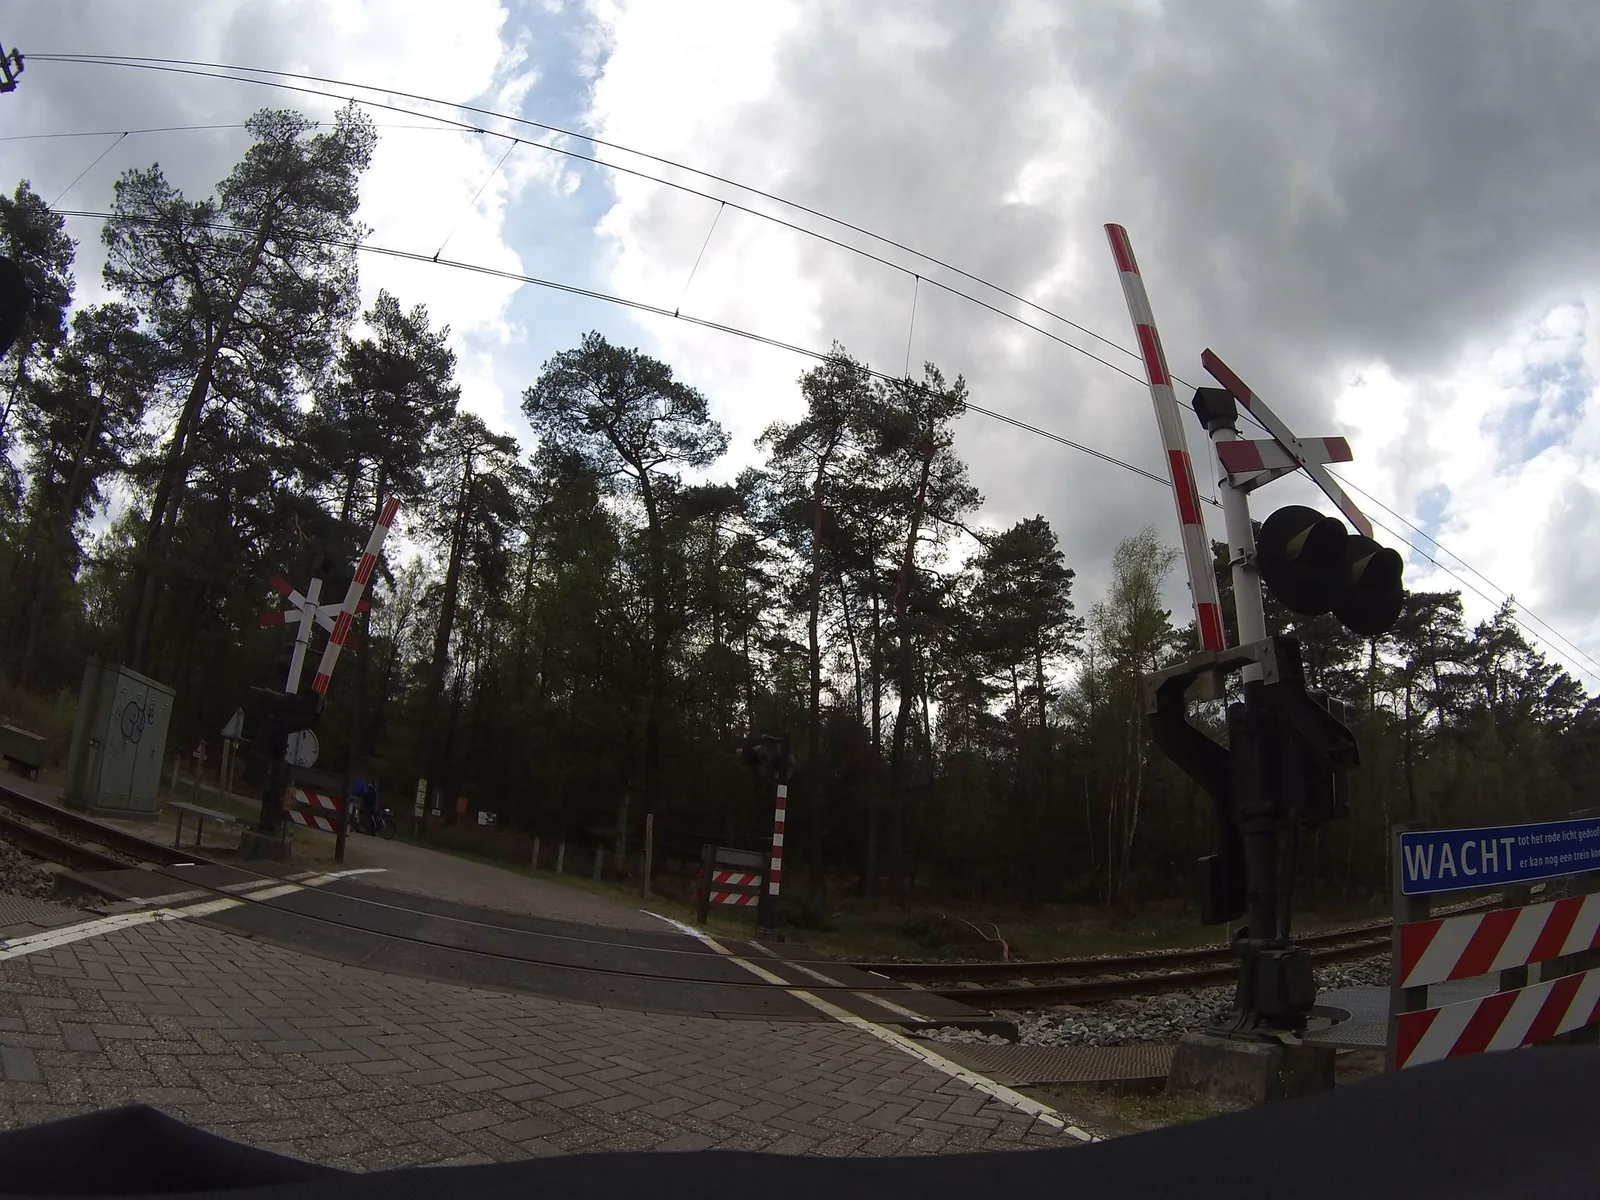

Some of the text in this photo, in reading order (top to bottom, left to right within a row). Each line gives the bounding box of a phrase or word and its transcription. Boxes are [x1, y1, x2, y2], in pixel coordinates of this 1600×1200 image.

[1518, 835, 1530, 846] tot
[1531, 834, 1544, 845] het
[1545, 832, 1561, 843] rode
[1561, 830, 1578, 841] licht
[1404, 837, 1515, 881] WACHT
[1519, 848, 1600, 869] er kan nog een trein ko
